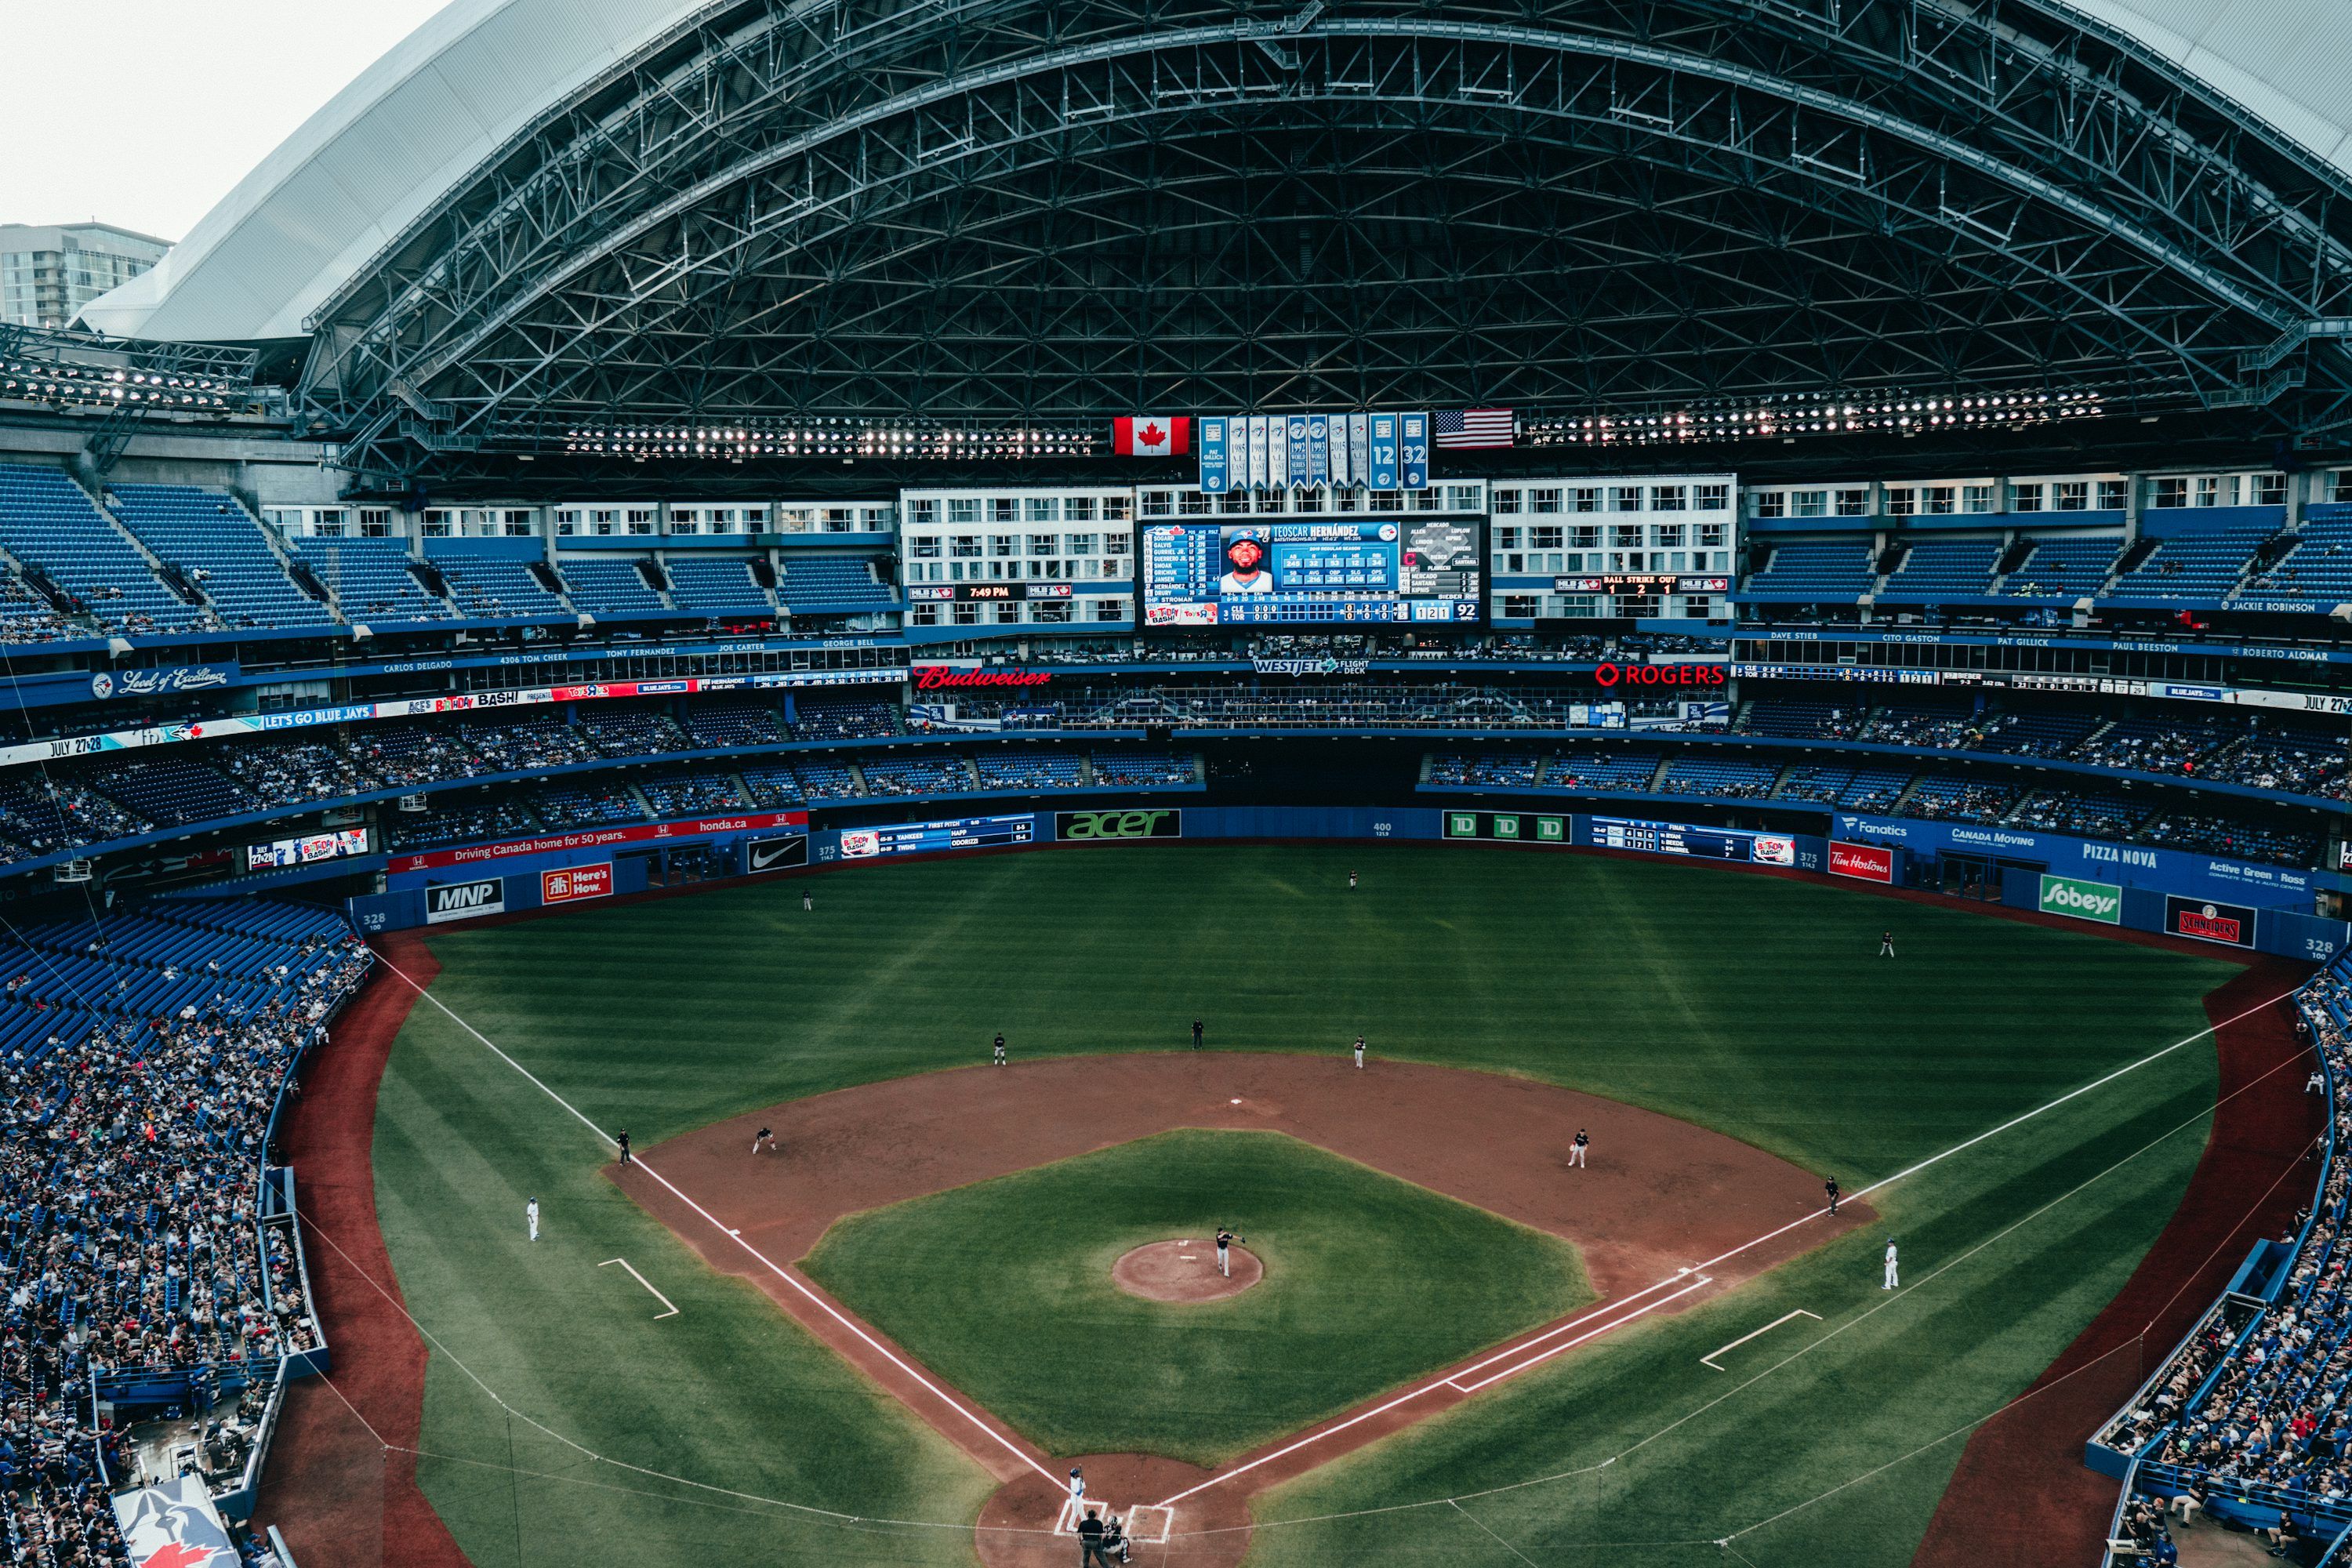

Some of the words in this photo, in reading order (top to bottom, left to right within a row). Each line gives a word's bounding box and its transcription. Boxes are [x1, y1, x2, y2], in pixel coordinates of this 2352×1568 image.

[1232, 444, 1245, 453] 1985
[1251, 444, 1265, 453] 1989
[1272, 444, 1284, 452] 1991
[1290, 442, 1305, 452] 1992
[1311, 442, 1325, 452] 1993
[1331, 442, 1345, 452] 2015
[1352, 441, 1366, 450] 2016
[1374, 447, 1394, 464] 12
[1403, 445, 1425, 464] 32
[1256, 528, 1270, 538] 37
[1274, 527, 1307, 537] TEOSCAR
[1311, 524, 1359, 536] HERNÁNDEZ
[1404, 554, 1416, 564] C
[971, 588, 991, 597] 7:49
[993, 587, 1009, 597] PM
[1610, 585, 1615, 593] 1
[1638, 585, 1645, 593] 2
[1664, 585, 1670, 593] 1
[1457, 604, 1475, 616] 92
[2233, 602, 2263, 611] JACKIE
[2267, 603, 2315, 612] ROBINSON
[631, 648, 675, 656] FERNANDEZ
[2138, 643, 2178, 652] BEESTON
[544, 653, 568, 662] CHEEK
[2243, 648, 2285, 659] ROBERTO
[2288, 651, 2328, 660] ALOMAR
[384, 664, 414, 673] CARLOS
[417, 661, 452, 670] DELGADO
[1255, 661, 1320, 675] WESTJET
[118, 670, 159, 693] Level
[172, 666, 227, 690] Excellence
[913, 666, 1051, 689] Budweiser
[1626, 665, 1723, 684] ROGERS
[478, 691, 519, 706] BASH!
[2304, 696, 2325, 710] JULY
[266, 715, 292, 728] LET'S
[295, 713, 312, 724] GO
[316, 710, 341, 723] BLUE
[344, 707, 368, 719] JAYS
[51, 740, 71, 757] JULY
[700, 820, 746, 831] honda.ca
[1066, 811, 1170, 838] acer
[1454, 818, 1474, 831] TD
[1496, 818, 1517, 833] TD
[1540, 821, 1560, 836] TD
[1860, 821, 1907, 837] Fanatics
[1952, 827, 1991, 841] CANADA
[1994, 832, 2034, 847] MOVING
[455, 848, 491, 861] Driving
[493, 843, 532, 855] Canada
[535, 840, 562, 849] home
[564, 836, 579, 846] for
[582, 834, 593, 844] 50
[596, 831, 626, 844] years.
[819, 845, 835, 856] 375
[307, 849, 331, 859] BASH!
[1800, 852, 1817, 863] 375
[2083, 843, 2119, 862] PIZZA
[2123, 848, 2157, 869] NOVA
[1831, 851, 1849, 866] Tim
[1850, 855, 1888, 873] Hortons
[572, 870, 607, 882] Here's
[2209, 861, 2241, 874] Active
[2244, 866, 2272, 880] Green
[2281, 873, 2305, 885] Ross
[2209, 872, 2239, 881] COMPLETE
[574, 884, 601, 895] How.
[437, 884, 493, 910] MNP
[2043, 884, 2117, 914] Sobeys
[364, 913, 386, 925] 328
[2183, 915, 2235, 938] SCHNEIDERS
[2306, 939, 2333, 953] 328
